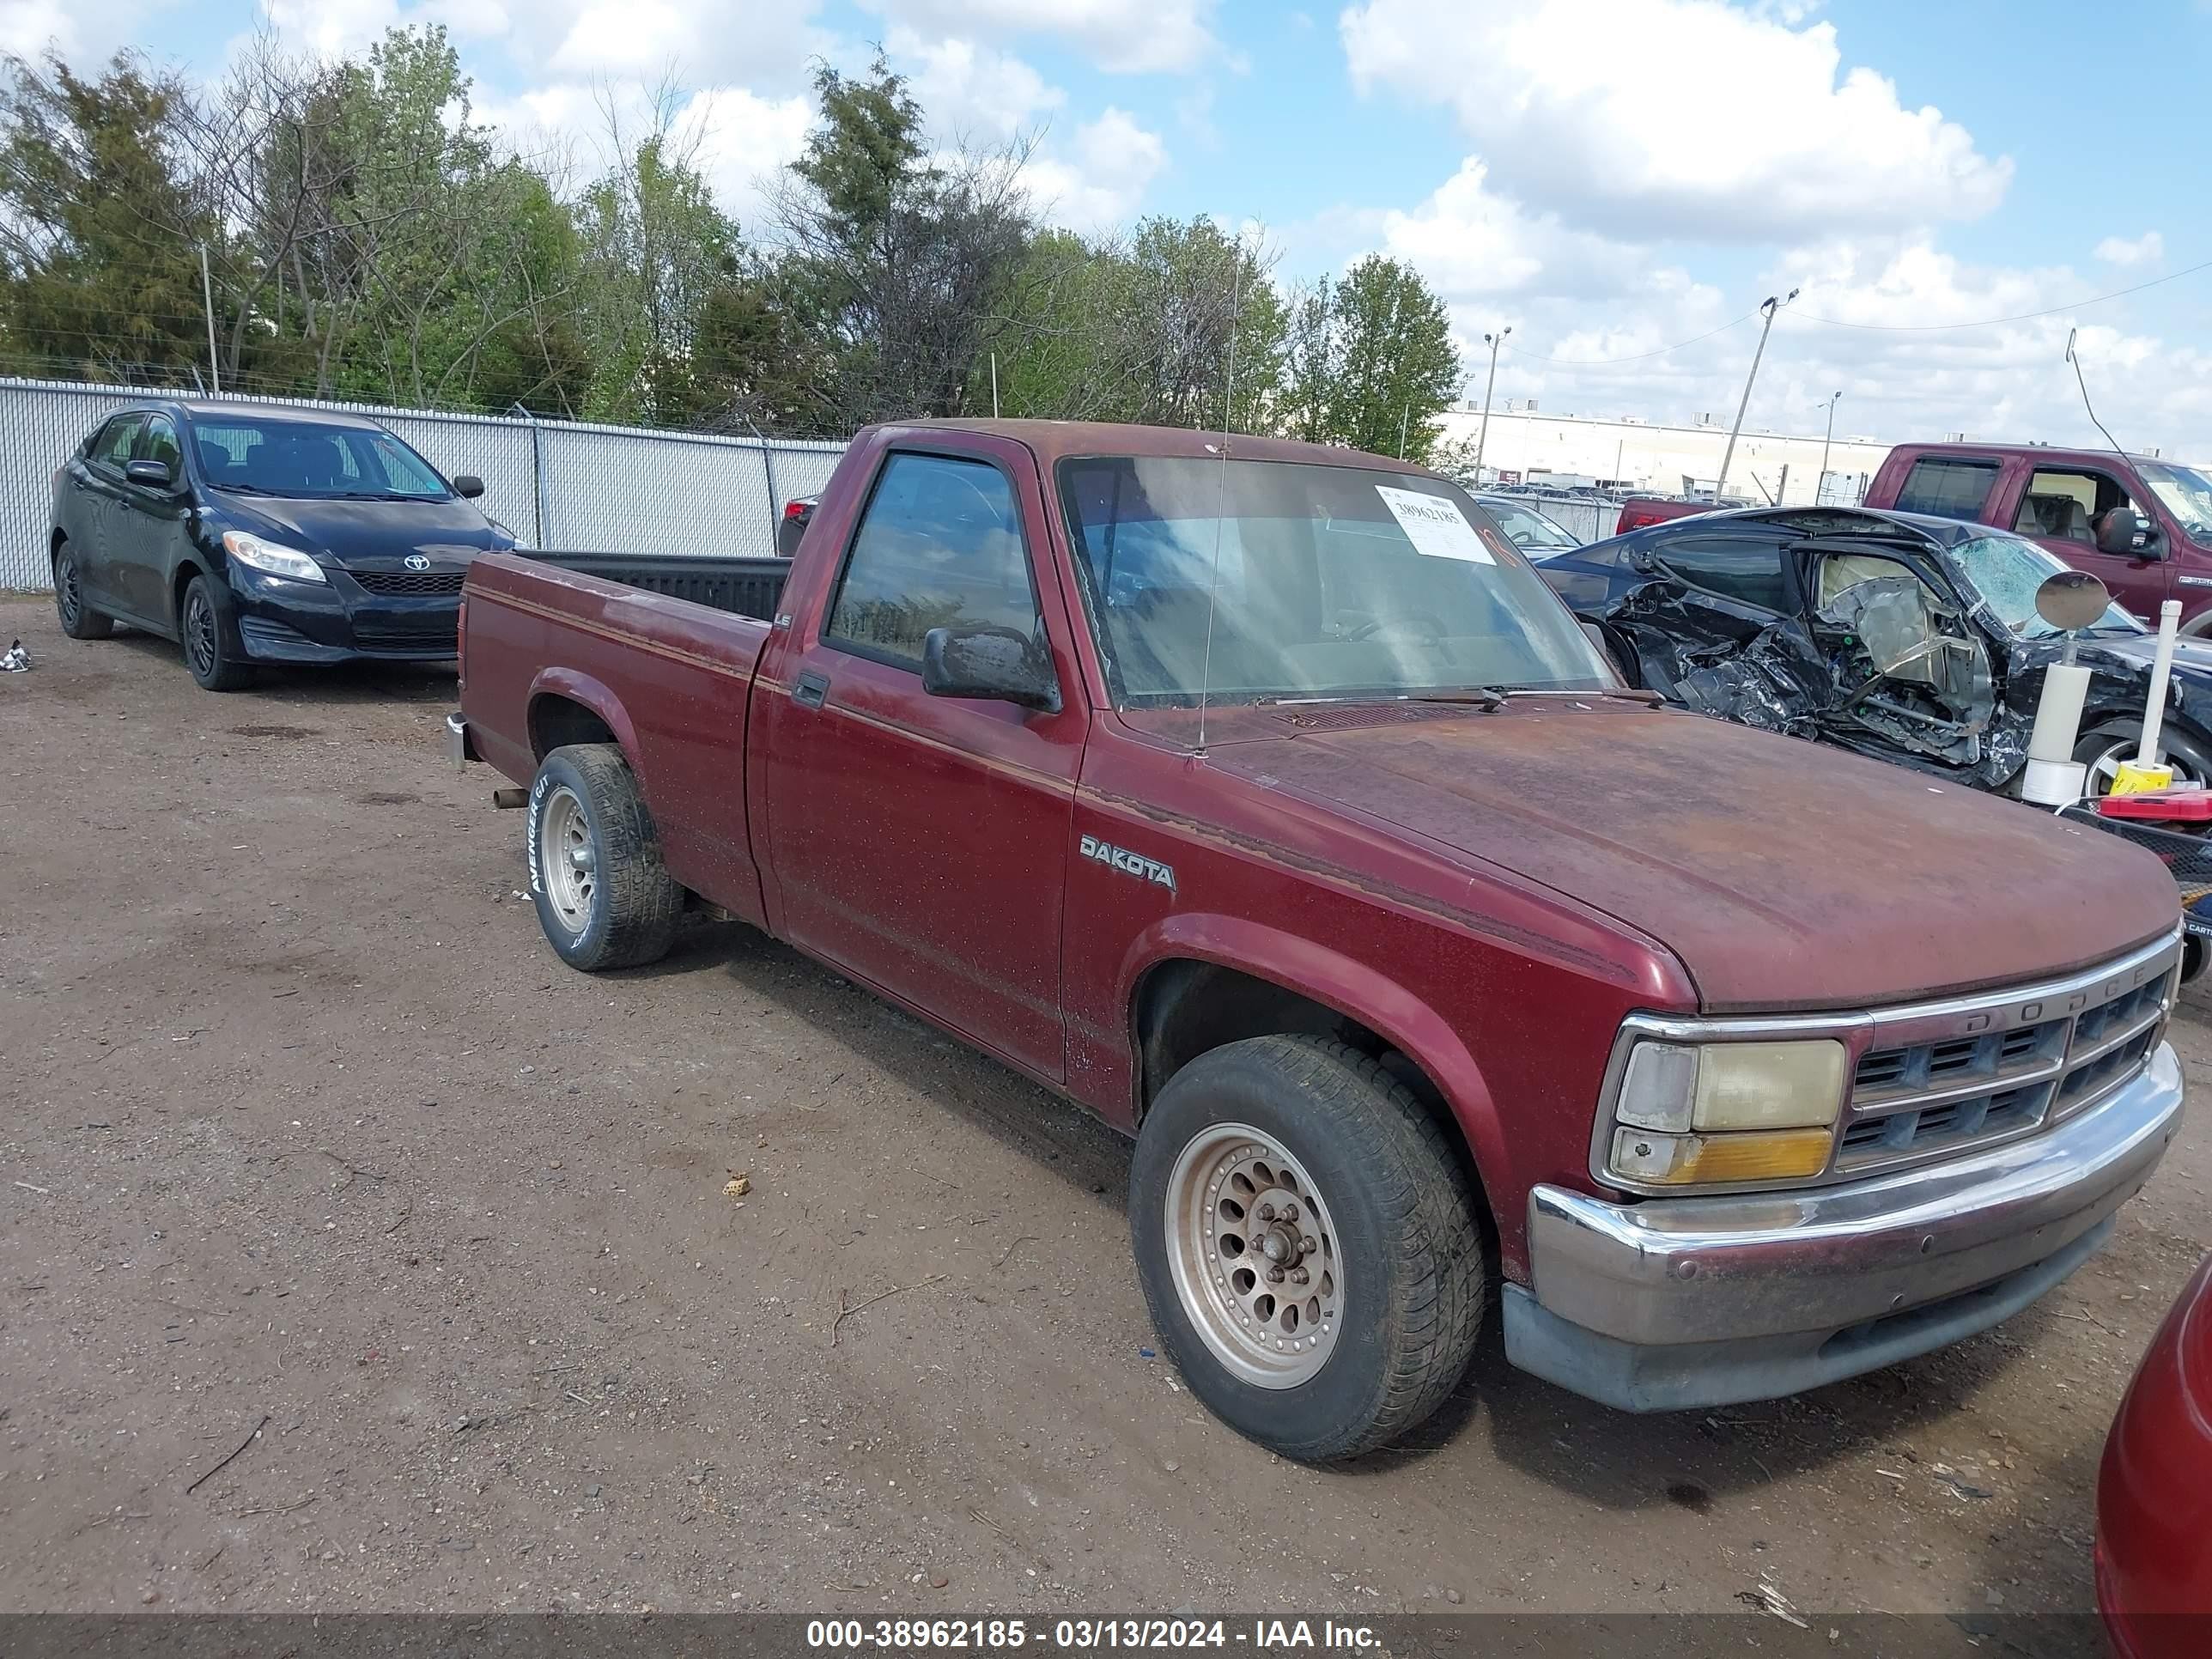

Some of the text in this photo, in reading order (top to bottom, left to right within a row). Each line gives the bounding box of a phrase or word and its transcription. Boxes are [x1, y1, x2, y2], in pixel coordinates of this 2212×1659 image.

[1395, 501, 1460, 524] 38962185
[527, 775, 550, 893] AVENGER G/T
[1079, 835, 1176, 890] DAKOTA
[1966, 967, 2146, 1031] DODGE
